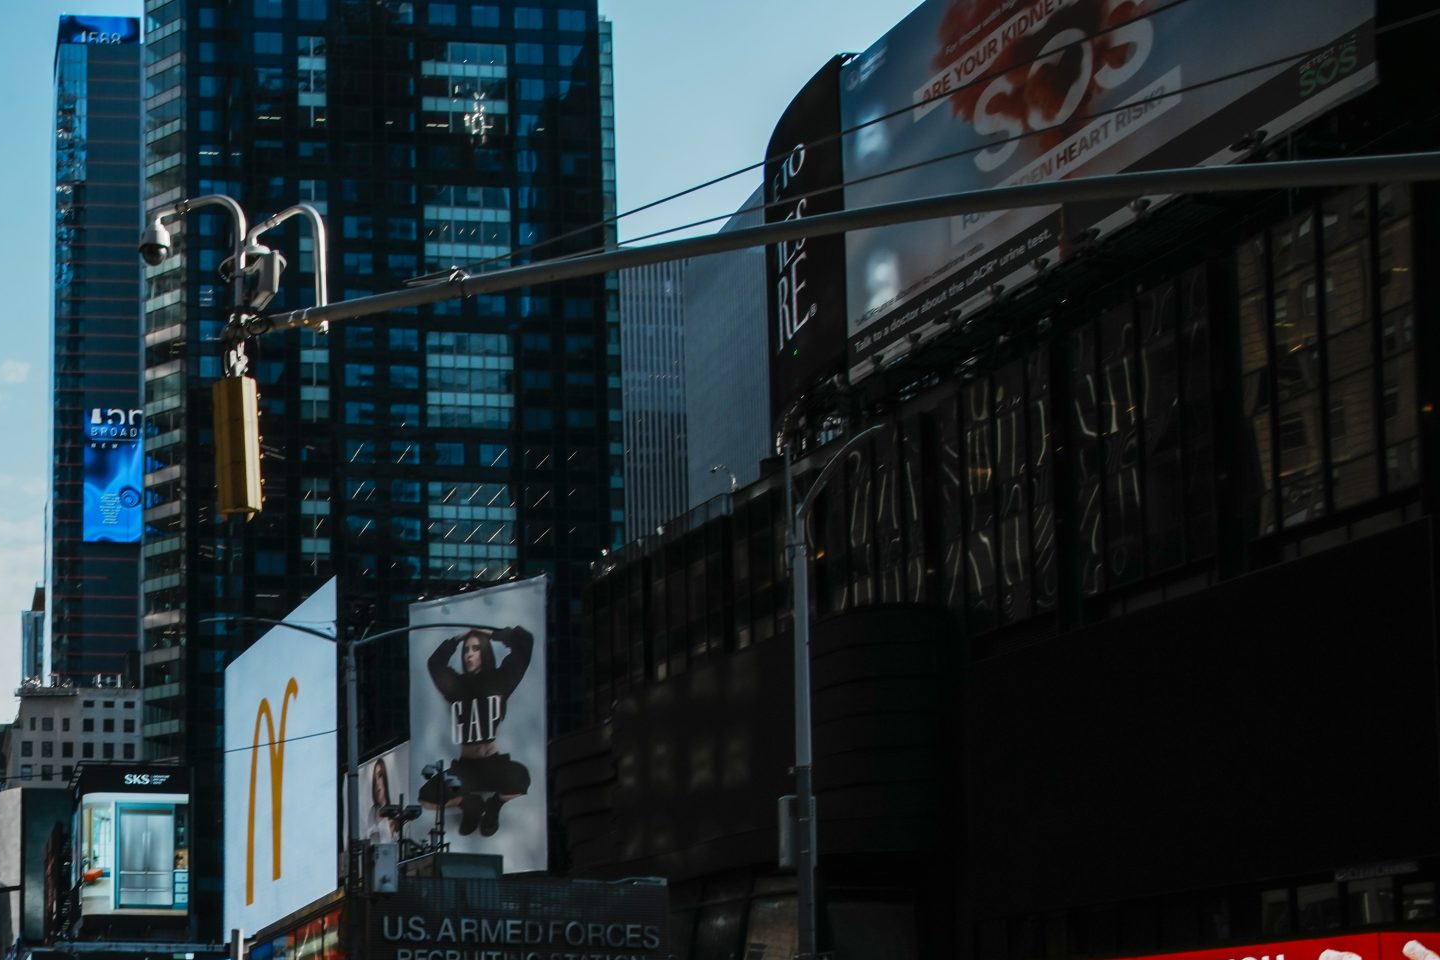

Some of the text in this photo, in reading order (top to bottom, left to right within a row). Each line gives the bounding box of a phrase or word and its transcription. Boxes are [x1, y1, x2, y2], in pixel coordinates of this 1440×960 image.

[921, 73, 952, 107] ARE
[953, 38, 998, 82] YOUR
[973, 0, 1155, 172] SOS
[1055, 118, 1112, 170] HEART
[854, 333, 872, 354] Talk
[890, 307, 919, 332] doctor
[920, 289, 948, 314] about
[948, 279, 964, 298] the
[999, 243, 1025, 268] urine
[1026, 227, 1052, 253] test.
[91, 427, 142, 437] BROAD
[450, 695, 501, 745] GAP
[124, 773, 150, 785] SKS
[383, 915, 659, 950] U.S. ARMED FORCES
